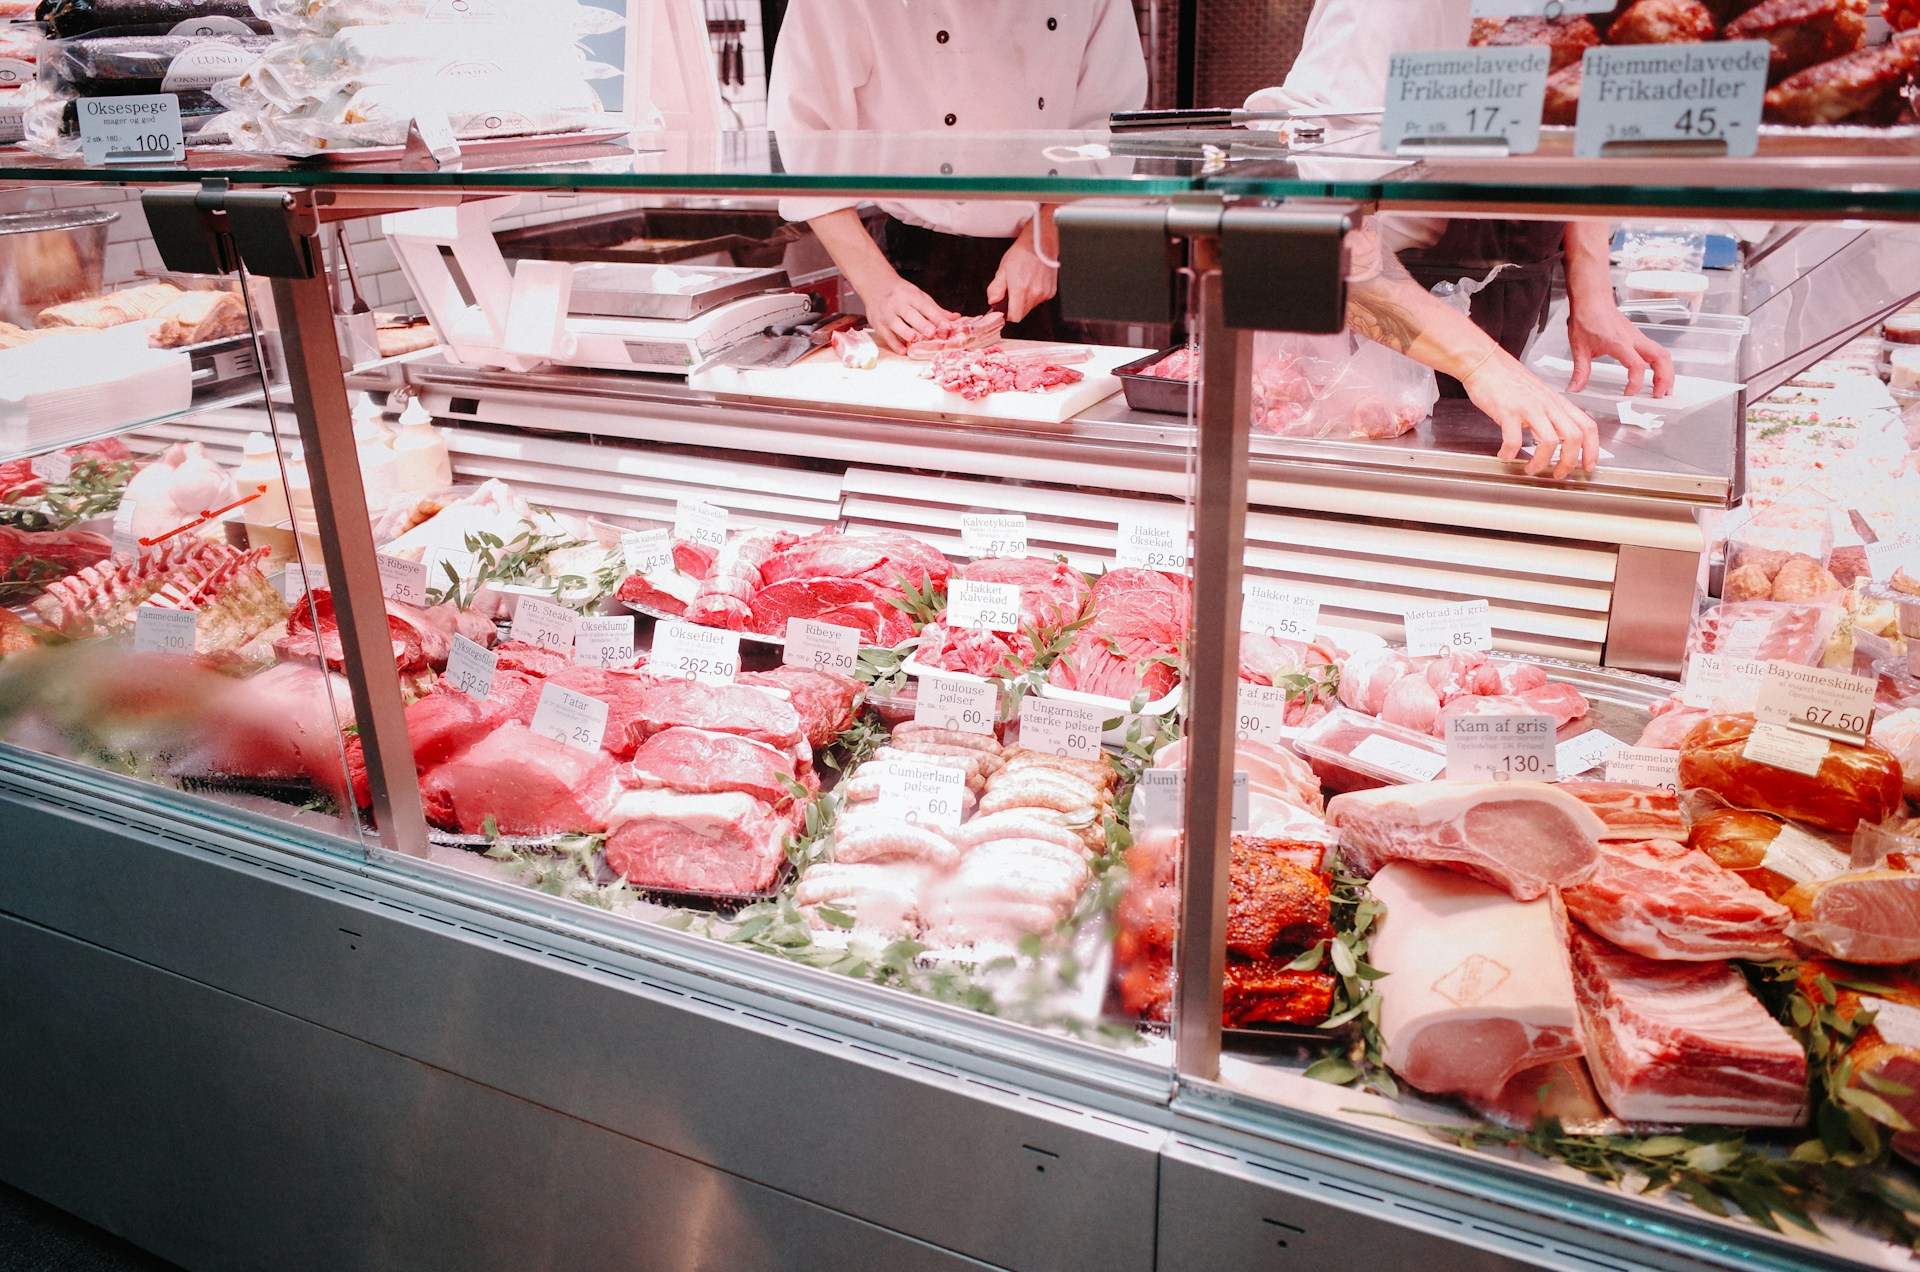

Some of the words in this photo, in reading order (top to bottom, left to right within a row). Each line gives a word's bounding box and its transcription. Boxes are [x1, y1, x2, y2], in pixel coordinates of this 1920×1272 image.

[1389, 54, 1546, 79] Hjemmelavede
[1585, 51, 1767, 78] Hjemmelavede
[1400, 79, 1529, 101] Frikadeller
[1599, 77, 1747, 101] Frikadeller
[87, 102, 168, 116] Oksespege
[1465, 106, 1520, 137] 17,-
[1674, 106, 1741, 139] 45,-
[136, 134, 182, 153] 100,-
[963, 517, 1025, 528] Kalvetykkam
[1134, 525, 1170, 538] Hakket
[695, 527, 723, 545] 52,50
[990, 540, 1025, 553] 67,50
[387, 557, 420, 574] Ribeye
[1148, 552, 1185, 568] 62,50
[395, 583, 419, 600] 55,-
[966, 582, 1002, 594] Hakket
[1251, 585, 1289, 602] Hakket
[1293, 596, 1315, 606] gris
[522, 599, 540, 614] Frb.
[542, 605, 574, 624] Steaks
[980, 609, 1017, 625] 62,50
[1453, 606, 1464, 616] af
[1468, 604, 1488, 616] gris
[581, 620, 628, 632] Okseklump
[806, 624, 842, 640] Ribeye
[1279, 619, 1307, 636] 55,-
[536, 628, 567, 648] 210,-
[670, 626, 724, 645] Oksefilet
[1453, 631, 1483, 647] 85,-
[601, 646, 632, 661] 92,50
[814, 650, 853, 669] 52,50
[679, 656, 734, 677] 262,50
[931, 678, 985, 696] Toulouse
[1767, 662, 1874, 696] Bayonneskinke
[562, 692, 588, 711] Tatar
[939, 693, 975, 706] pølser
[1246, 688, 1259, 698] af
[1262, 690, 1285, 702] gris
[963, 709, 991, 727] 60,-
[1032, 700, 1094, 721] Ungarnske
[1023, 713, 1061, 727] stærke
[1065, 720, 1101, 734] pølser
[1239, 715, 1271, 735] 90,-
[1454, 718, 1490, 733] Kam
[1495, 718, 1511, 732] af
[1516, 718, 1548, 735] gris
[572, 725, 599, 746] 25,-
[1067, 734, 1097, 752] 60,-
[888, 762, 960, 785] Cumberland
[1502, 755, 1554, 775] 130,-
[928, 798, 958, 817] 60,-
